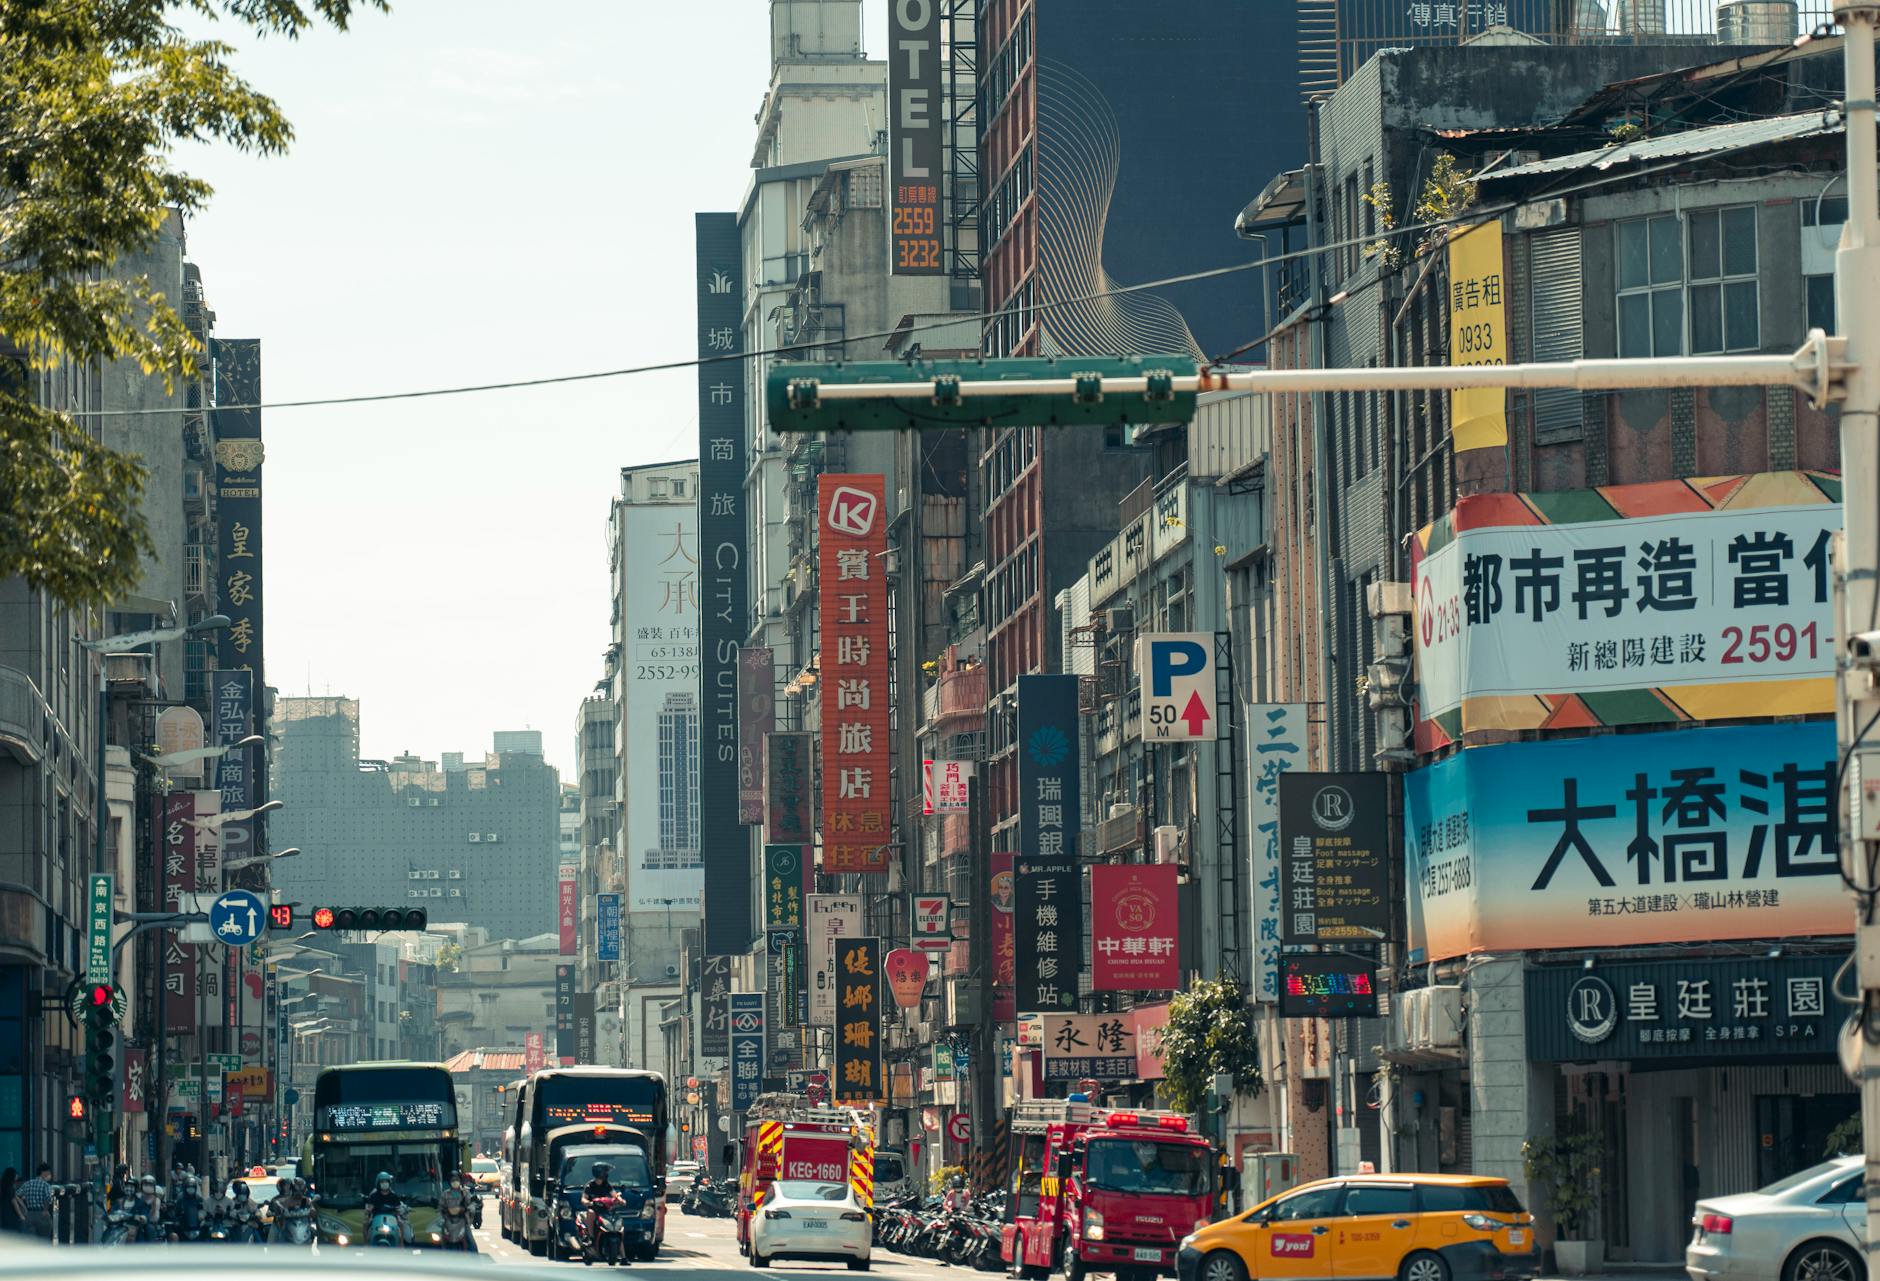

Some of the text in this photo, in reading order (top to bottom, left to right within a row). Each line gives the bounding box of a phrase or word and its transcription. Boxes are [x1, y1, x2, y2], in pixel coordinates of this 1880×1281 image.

[893, 207, 934, 234] 2559
[899, 239, 939, 267] 3232
[1453, 274, 1502, 312] 廣告租
[1459, 323, 1492, 353] 0933
[708, 328, 737, 516] 城市商旅
[223, 488, 257, 497] HOTEL
[227, 522, 254, 670] 皇家季
[1463, 537, 1699, 627] 都市再造
[637, 626, 700, 640] 盛裝 百年
[1437, 596, 1460, 644] 21-35
[651, 646, 698, 658] 65-138
[716, 542, 740, 762] CITY SUITES
[1151, 641, 1207, 697] P
[1567, 633, 1707, 672] 新總陽建設
[836, 549, 872, 799] 賓王時尚旅店
[1150, 704, 1177, 724] 50
[1157, 726, 1170, 737] M
[946, 762, 960, 783] 巧門
[828, 810, 886, 833] 休息
[1527, 760, 1838, 891] 大橋湛
[1315, 848, 1334, 857] Foot
[1291, 835, 1316, 936] 皇廷莊園
[1316, 887, 1335, 897] Body
[94, 887, 108, 946] 南京西路
[165, 821, 190, 997] 名家西公司
[271, 906, 291, 926] 43
[1036, 878, 1059, 1006] 手機維修站
[1097, 936, 1175, 958] 中華軒
[1627, 975, 1825, 1022] 皇廷莊園
[1055, 1019, 1134, 1053] 永隆
[737, 1039, 759, 1080] 全聯
[788, 1161, 843, 1181] KEG-1660
